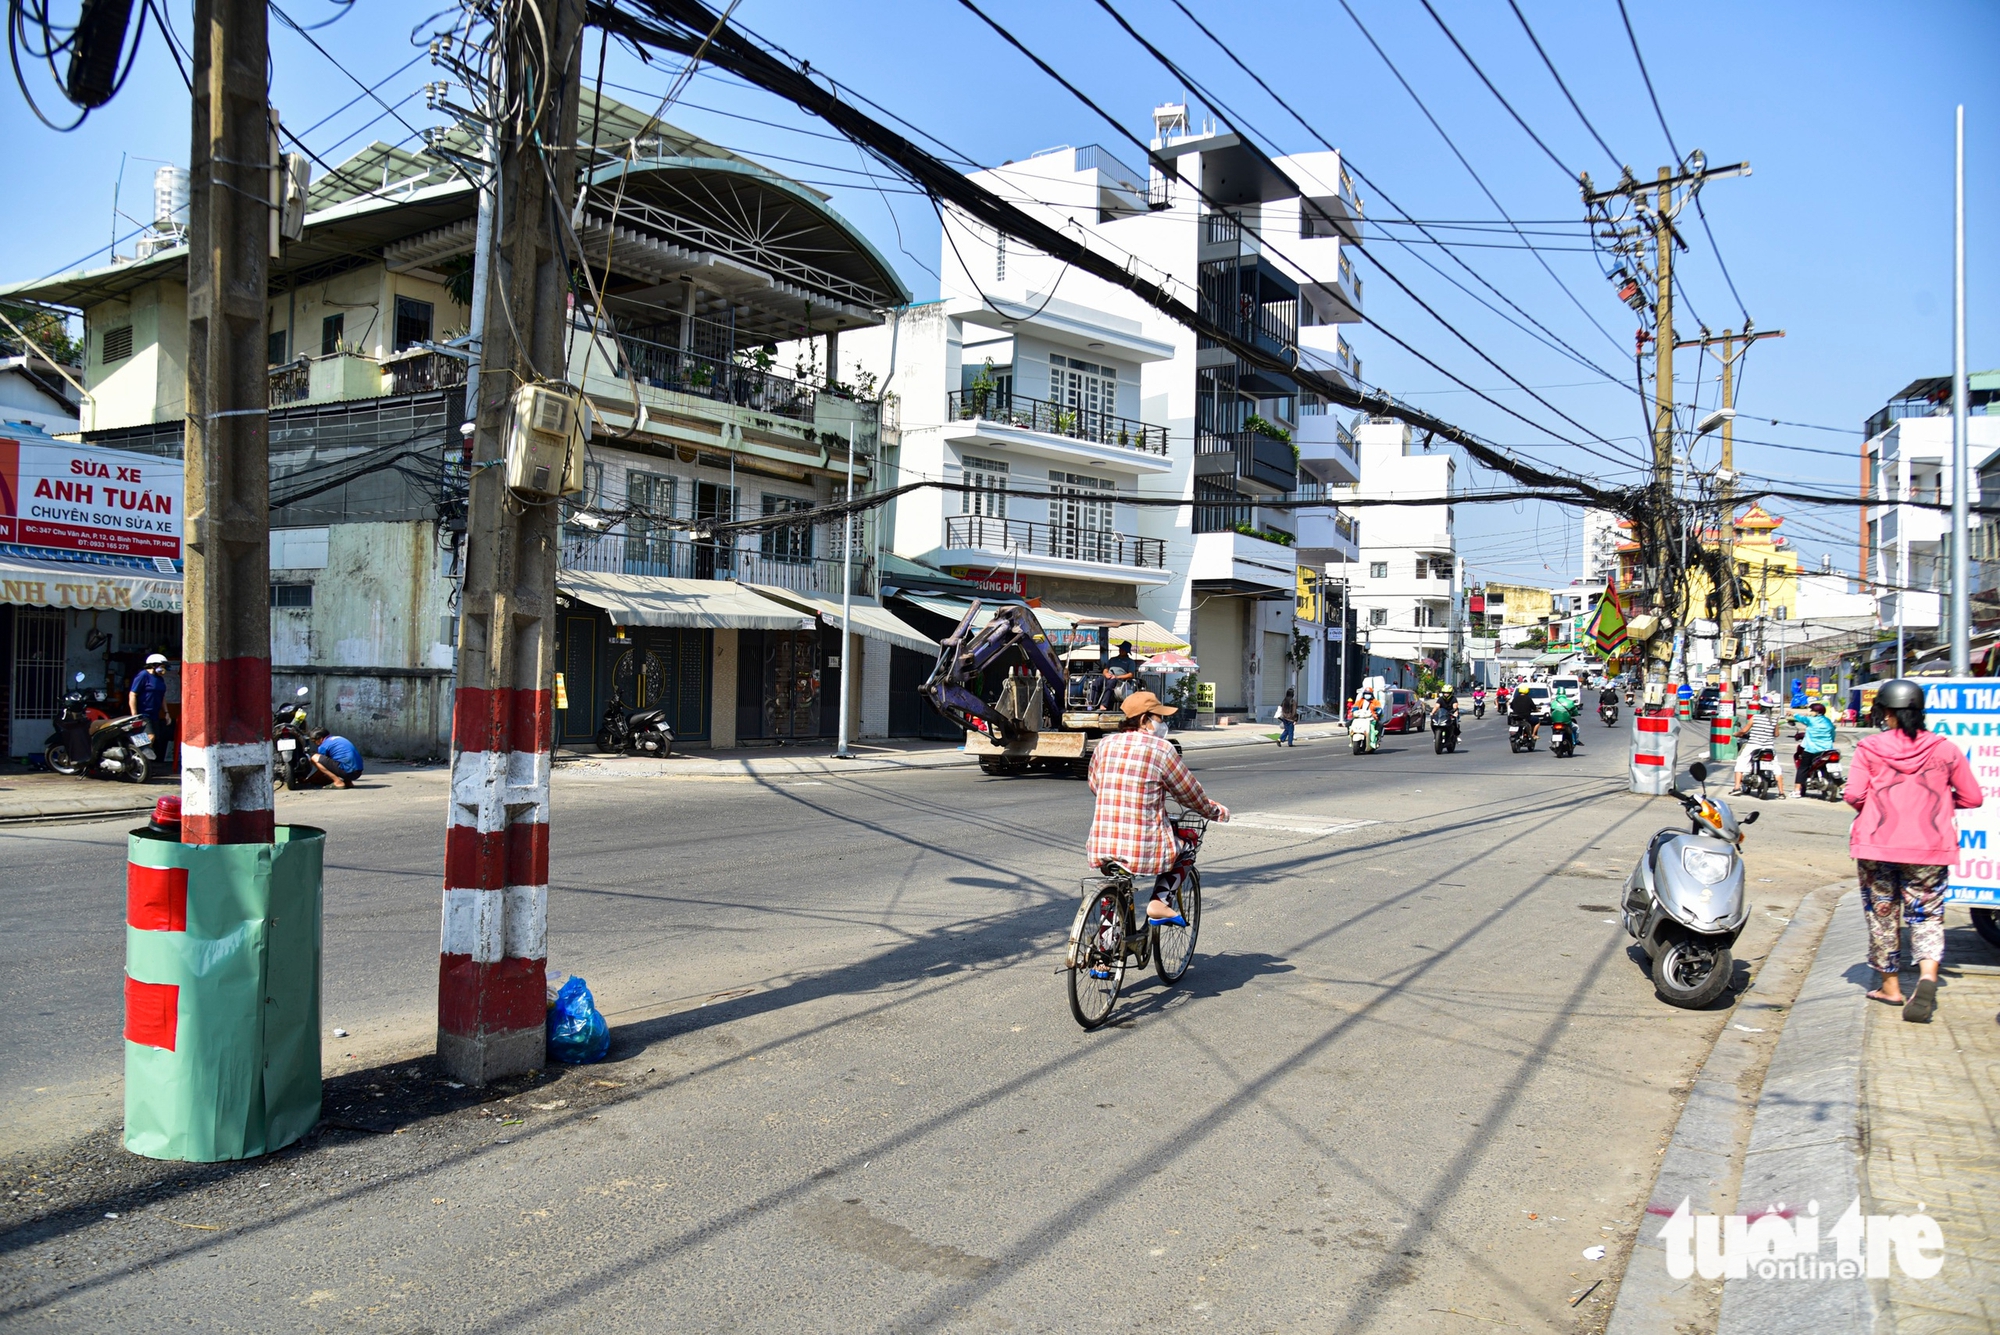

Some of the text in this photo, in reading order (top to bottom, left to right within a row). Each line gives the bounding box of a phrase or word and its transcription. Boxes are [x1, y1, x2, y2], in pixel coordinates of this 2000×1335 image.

[70, 458, 142, 484] SỬA XE
[34, 478, 172, 515] ANH TUẤN
[31, 505, 172, 533] CHUYÊN SƠN SỬA XE
[52, 528, 66, 536] Chu
[89, 540, 105, 548] 0933
[0, 579, 47, 604] NH
[167, 600, 182, 610] XE
[1924, 684, 1958, 710] ÁN
[1932, 719, 2000, 736] ÁNH
[1959, 829, 1987, 849] M
[1954, 856, 2000, 880] ƯỜ
